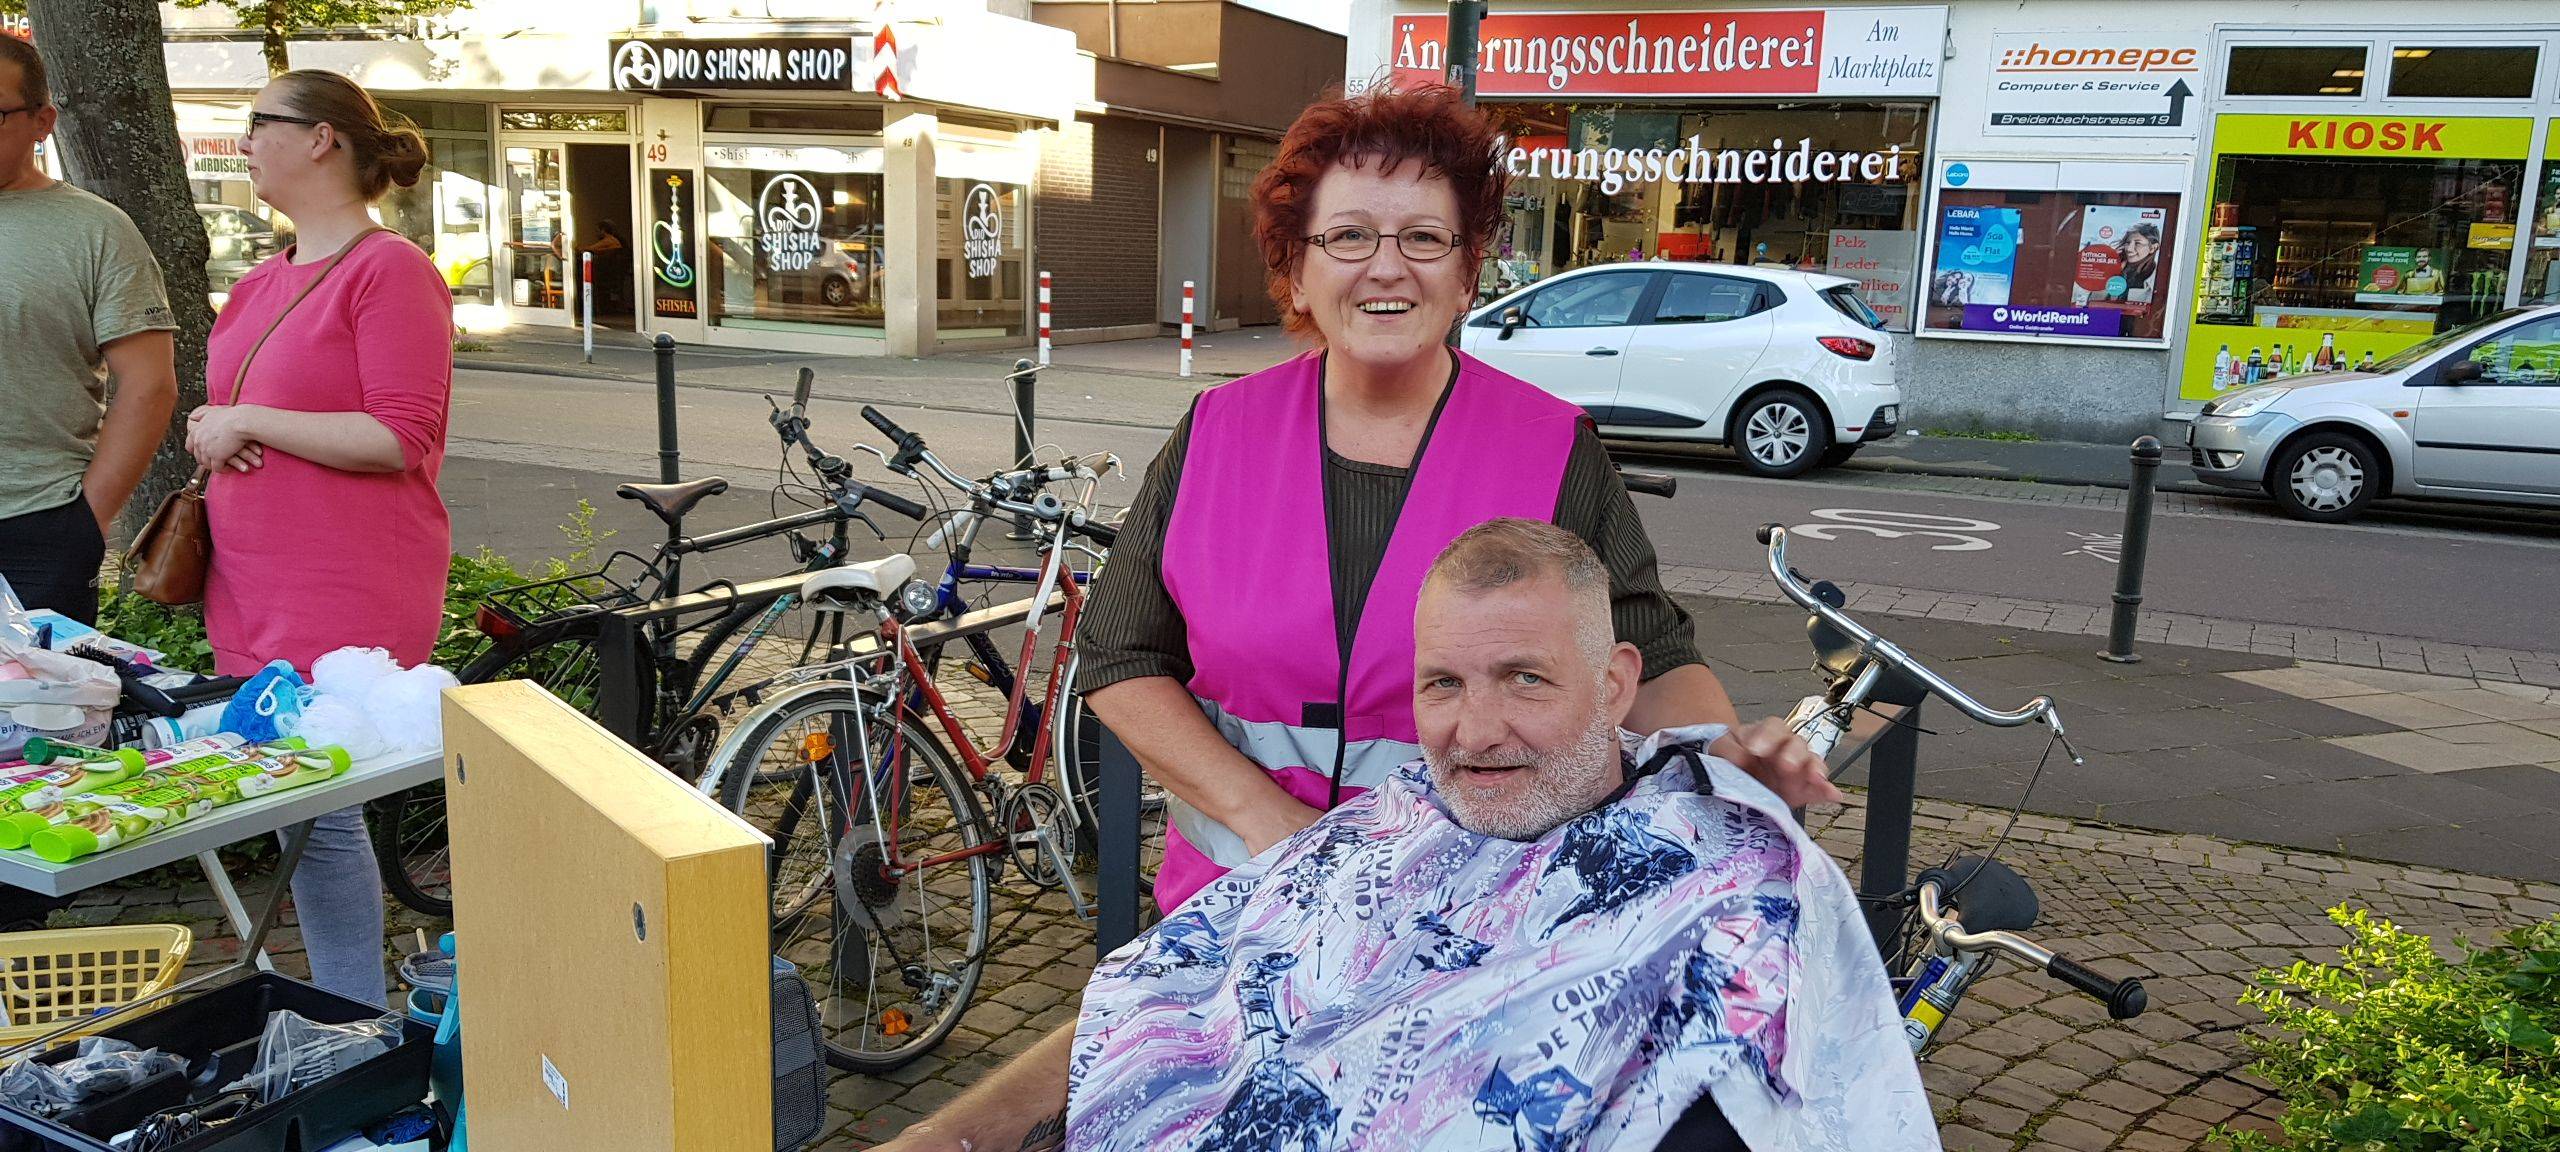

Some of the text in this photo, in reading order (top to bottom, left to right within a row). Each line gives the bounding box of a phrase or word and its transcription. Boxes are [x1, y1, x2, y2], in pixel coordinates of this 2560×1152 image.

[1866, 18, 1900, 42] Am
[1394, 19, 1815, 90] Änrungsschneiderei
[662, 48, 846, 82] DIO SHISHA SHOP
[1828, 54, 1934, 87] Marktplatz
[1349, 79, 1364, 93] 55
[1998, 81, 2160, 93] Computer & Service
[2001, 114, 2170, 125] Breidenbachstrasse 19
[903, 138, 913, 147] 49
[2288, 121, 2447, 151] KIOSK
[193, 138, 237, 155] KOMELA
[647, 144, 667, 162] 49
[194, 158, 249, 173] KURDISCHE
[1947, 210, 1980, 219] LEBARA
[776, 219, 793, 232] DIO
[761, 231, 821, 253] SHISHA
[964, 239, 1002, 259] SHISHA
[1834, 235, 1867, 248] Pelz
[770, 250, 814, 273] SHOP
[969, 257, 997, 279] SHOP
[1832, 257, 1881, 270] Leder
[656, 299, 696, 313] SHISHA
[2011, 309, 2089, 325] WorldRemit
[1551, 965, 1661, 1013] COURSES
[1536, 1026, 1570, 1061] DE
[1389, 1006, 1433, 1106] COURSES
